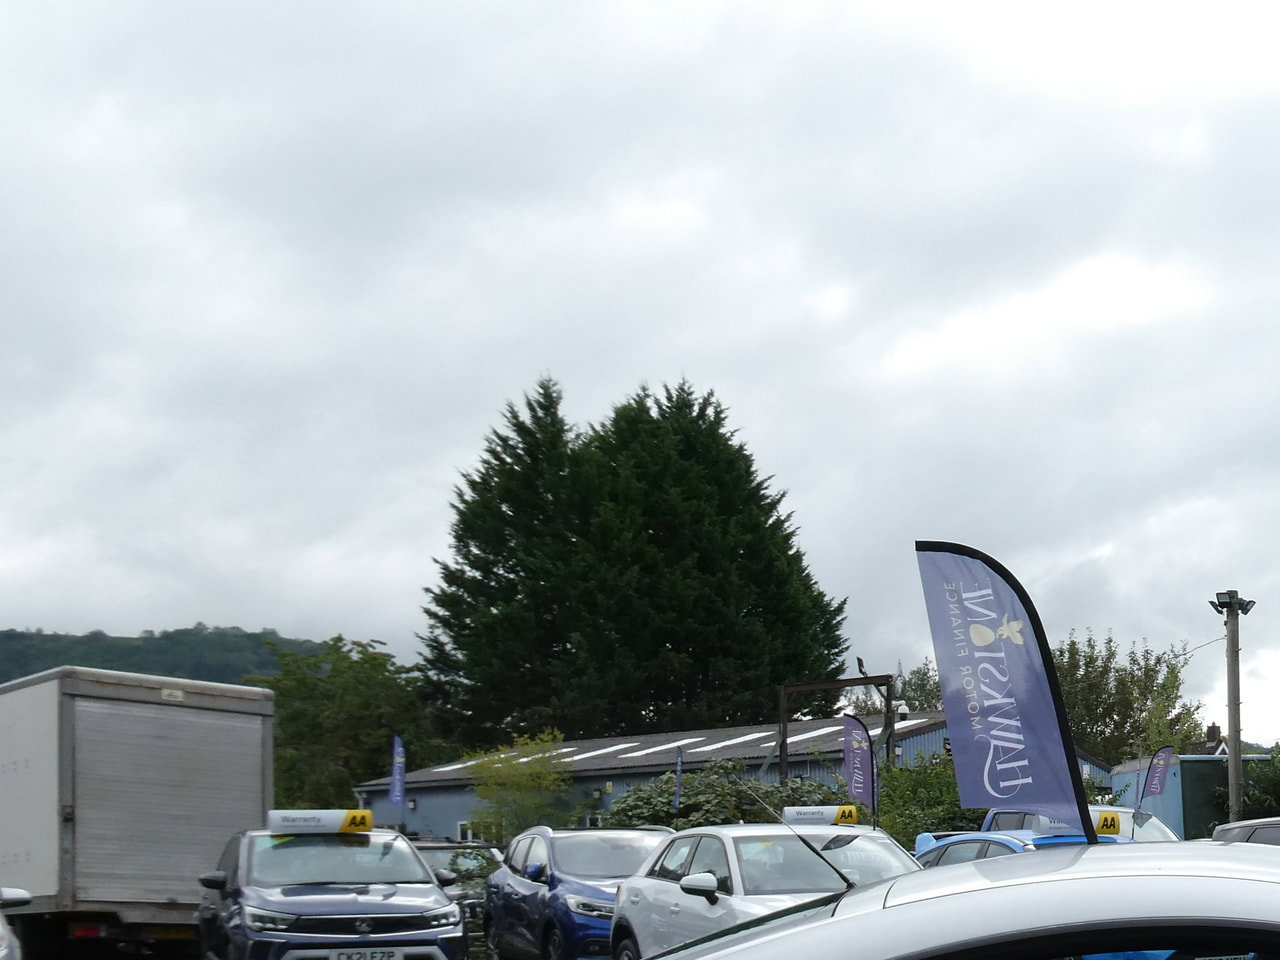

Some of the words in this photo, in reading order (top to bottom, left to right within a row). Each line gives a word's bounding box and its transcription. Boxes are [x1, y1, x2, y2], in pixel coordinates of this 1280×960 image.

[840, 810, 853, 820] AA
[281, 815, 321, 824] Warranty
[347, 815, 368, 828] AA
[1101, 817, 1116, 829] AA
